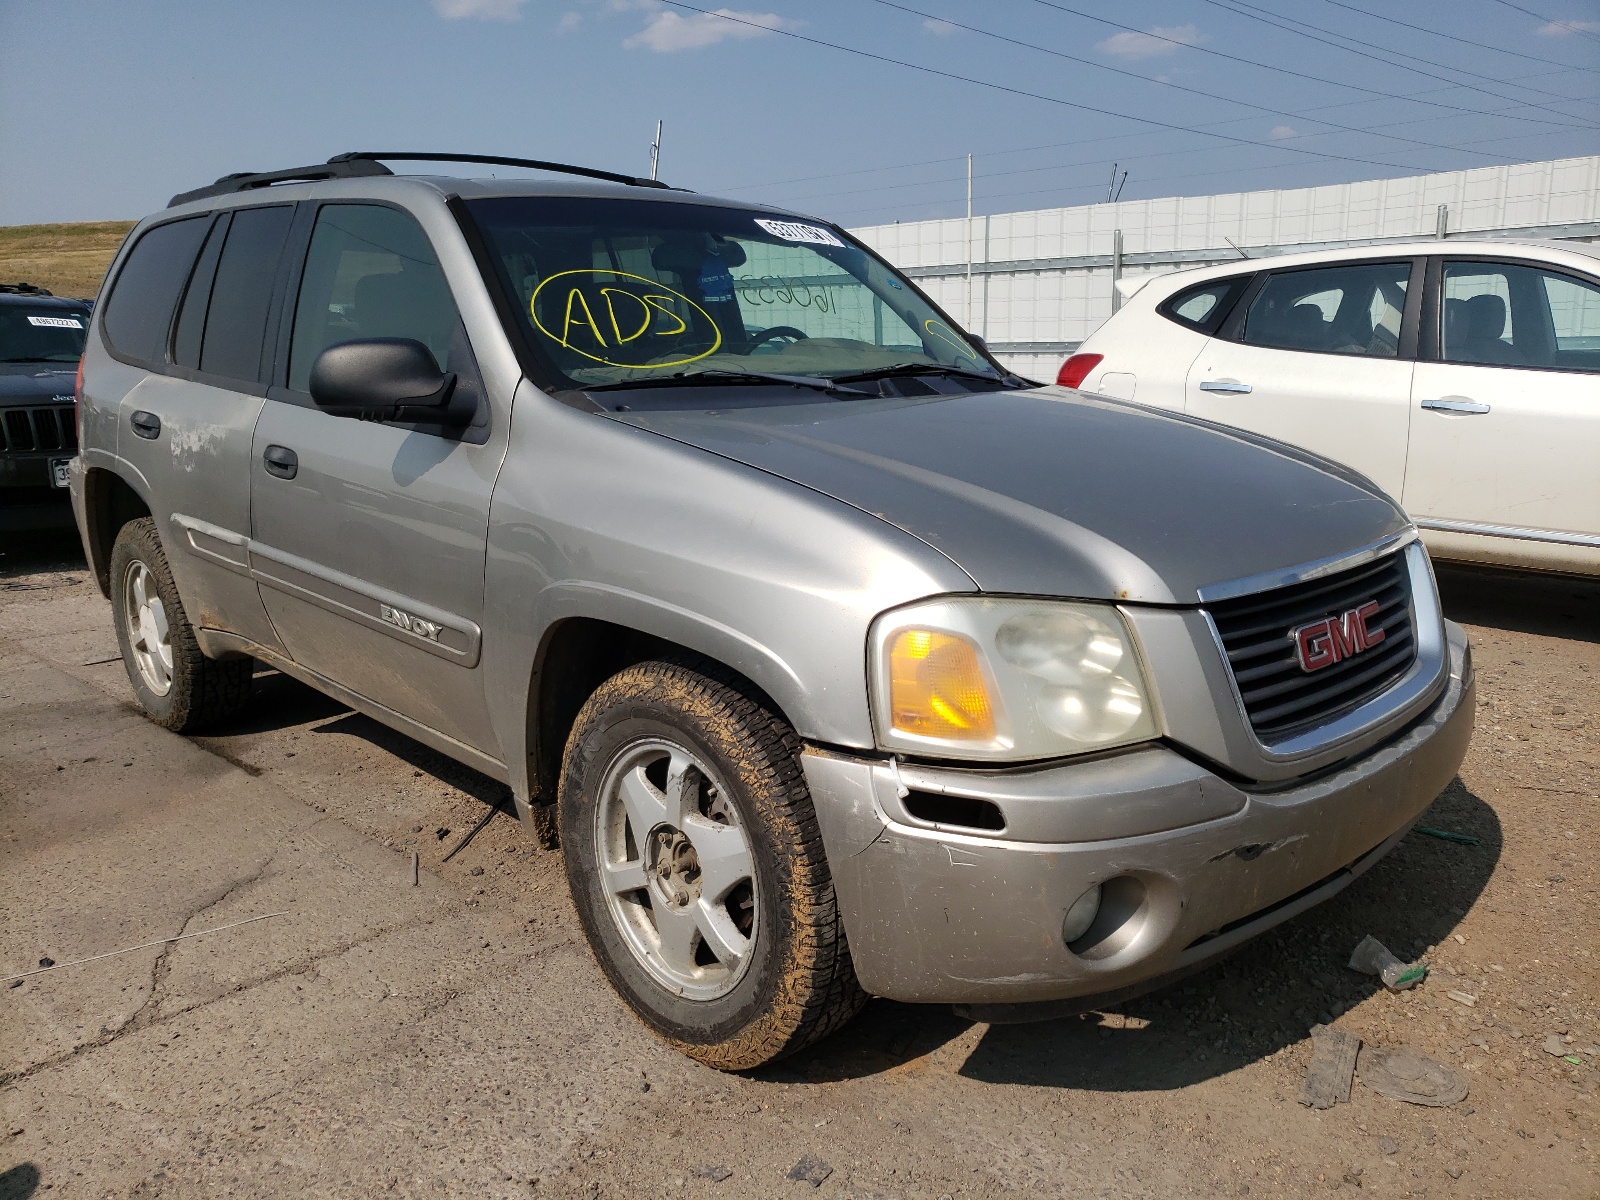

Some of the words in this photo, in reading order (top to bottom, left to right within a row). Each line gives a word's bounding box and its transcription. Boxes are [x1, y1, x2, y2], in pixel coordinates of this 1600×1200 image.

[562, 288, 687, 349] ADS
[380, 603, 443, 642] ENVOY
[1295, 599, 1386, 674] GMC
